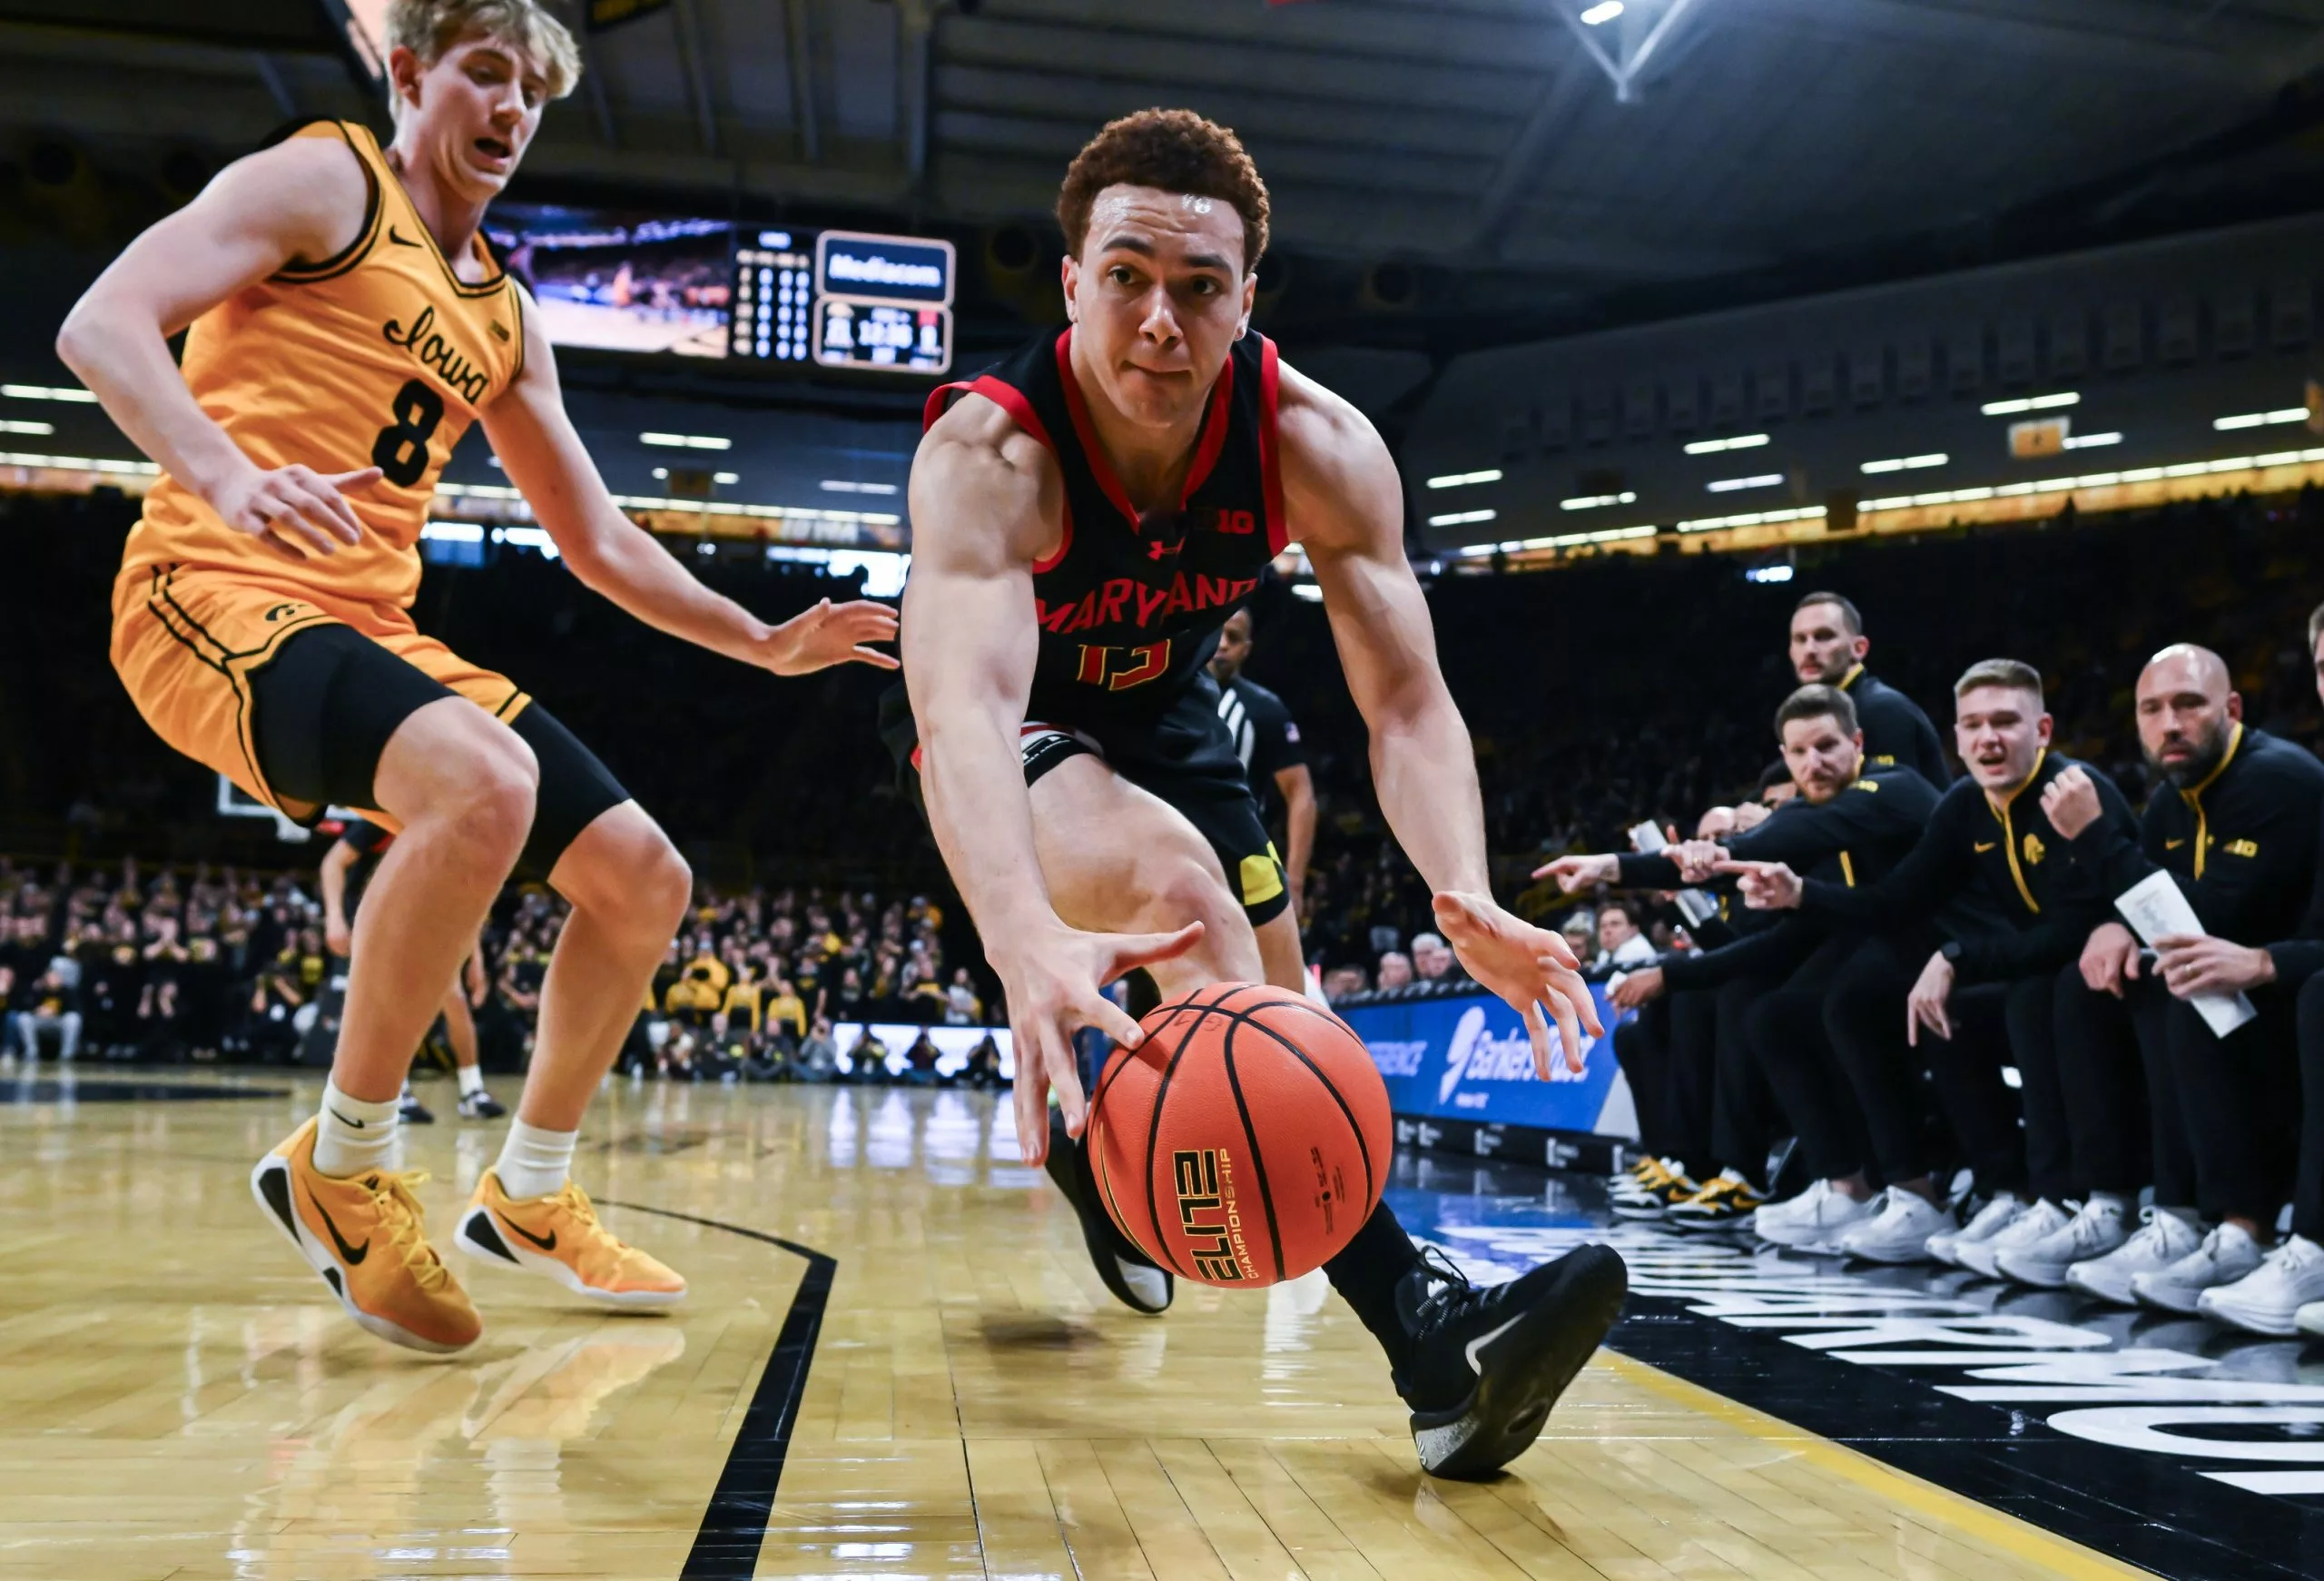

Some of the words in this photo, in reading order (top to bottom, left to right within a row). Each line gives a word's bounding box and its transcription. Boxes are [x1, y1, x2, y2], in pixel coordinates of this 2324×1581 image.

[382, 305, 488, 405] Iowa
[371, 378, 445, 488] 8
[1173, 1149, 1246, 1281] ELITE
[1219, 1148, 1260, 1280] CHAMPIONSHIP
